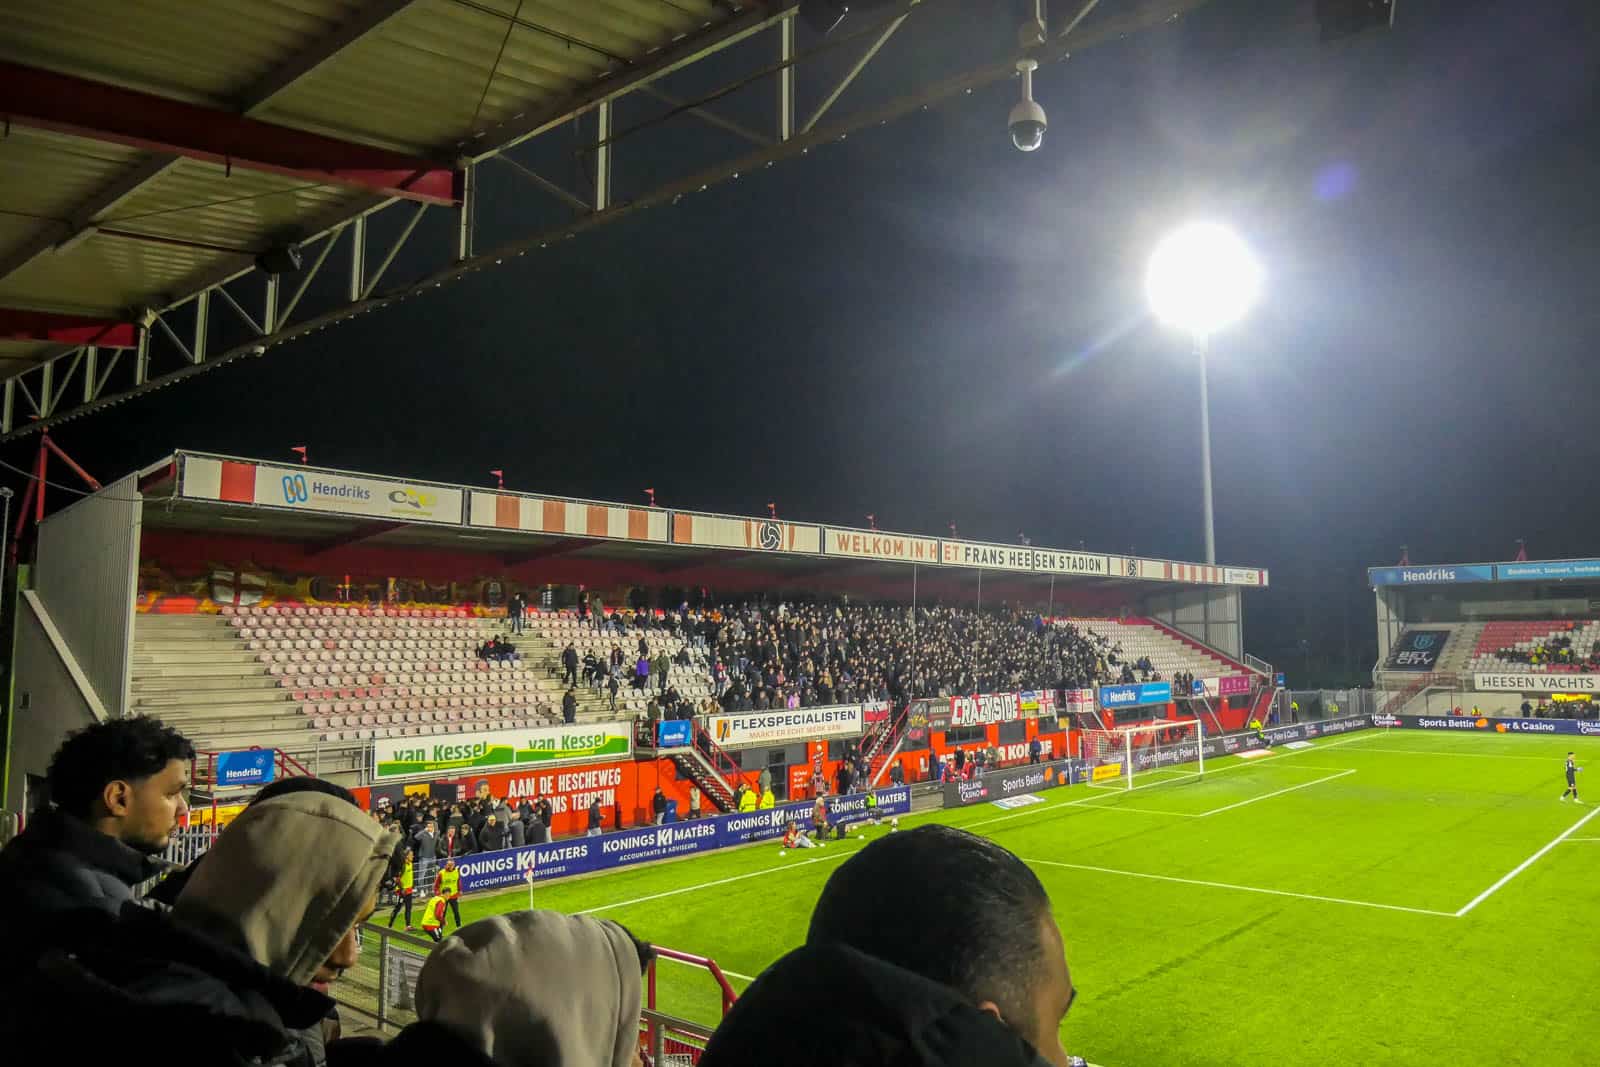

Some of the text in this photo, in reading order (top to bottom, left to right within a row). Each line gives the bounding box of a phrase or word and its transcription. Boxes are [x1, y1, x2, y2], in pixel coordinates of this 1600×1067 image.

[312, 481, 370, 500] Hendriks
[836, 533, 904, 556] WELKOM
[910, 541, 923, 558] IN
[964, 546, 1005, 566] FRANS
[1009, 551, 1056, 569] HEESEN
[1059, 555, 1101, 572] STADION
[1403, 569, 1456, 581] Hendriks
[1482, 676, 1595, 689] HEESEN YACHTS
[1110, 691, 1136, 702] Hendriks
[732, 710, 856, 731] FLEXSPECIALISTEN
[1419, 718, 1475, 728] Sports Bettin
[1512, 722, 1520, 730] &
[1521, 721, 1555, 731] Casino
[528, 731, 606, 751] van Kessel
[394, 741, 488, 762] van Kessel
[226, 768, 263, 779] Hendriks
[508, 768, 621, 798] AAN DE HESCHEWEG
[1002, 773, 1045, 793] Sports Bettin
[877, 791, 907, 805] MATERS
[727, 814, 770, 832] KONINGS
[603, 834, 655, 853] KONINGS
[674, 823, 716, 841] MATERS
[458, 856, 514, 878] ONINGS
[538, 845, 588, 865] MATERS
[618, 848, 661, 862] ACCOUNTANTS
[668, 842, 698, 853] ADVISEURS
[469, 874, 521, 889] ACCOUNTANTS
